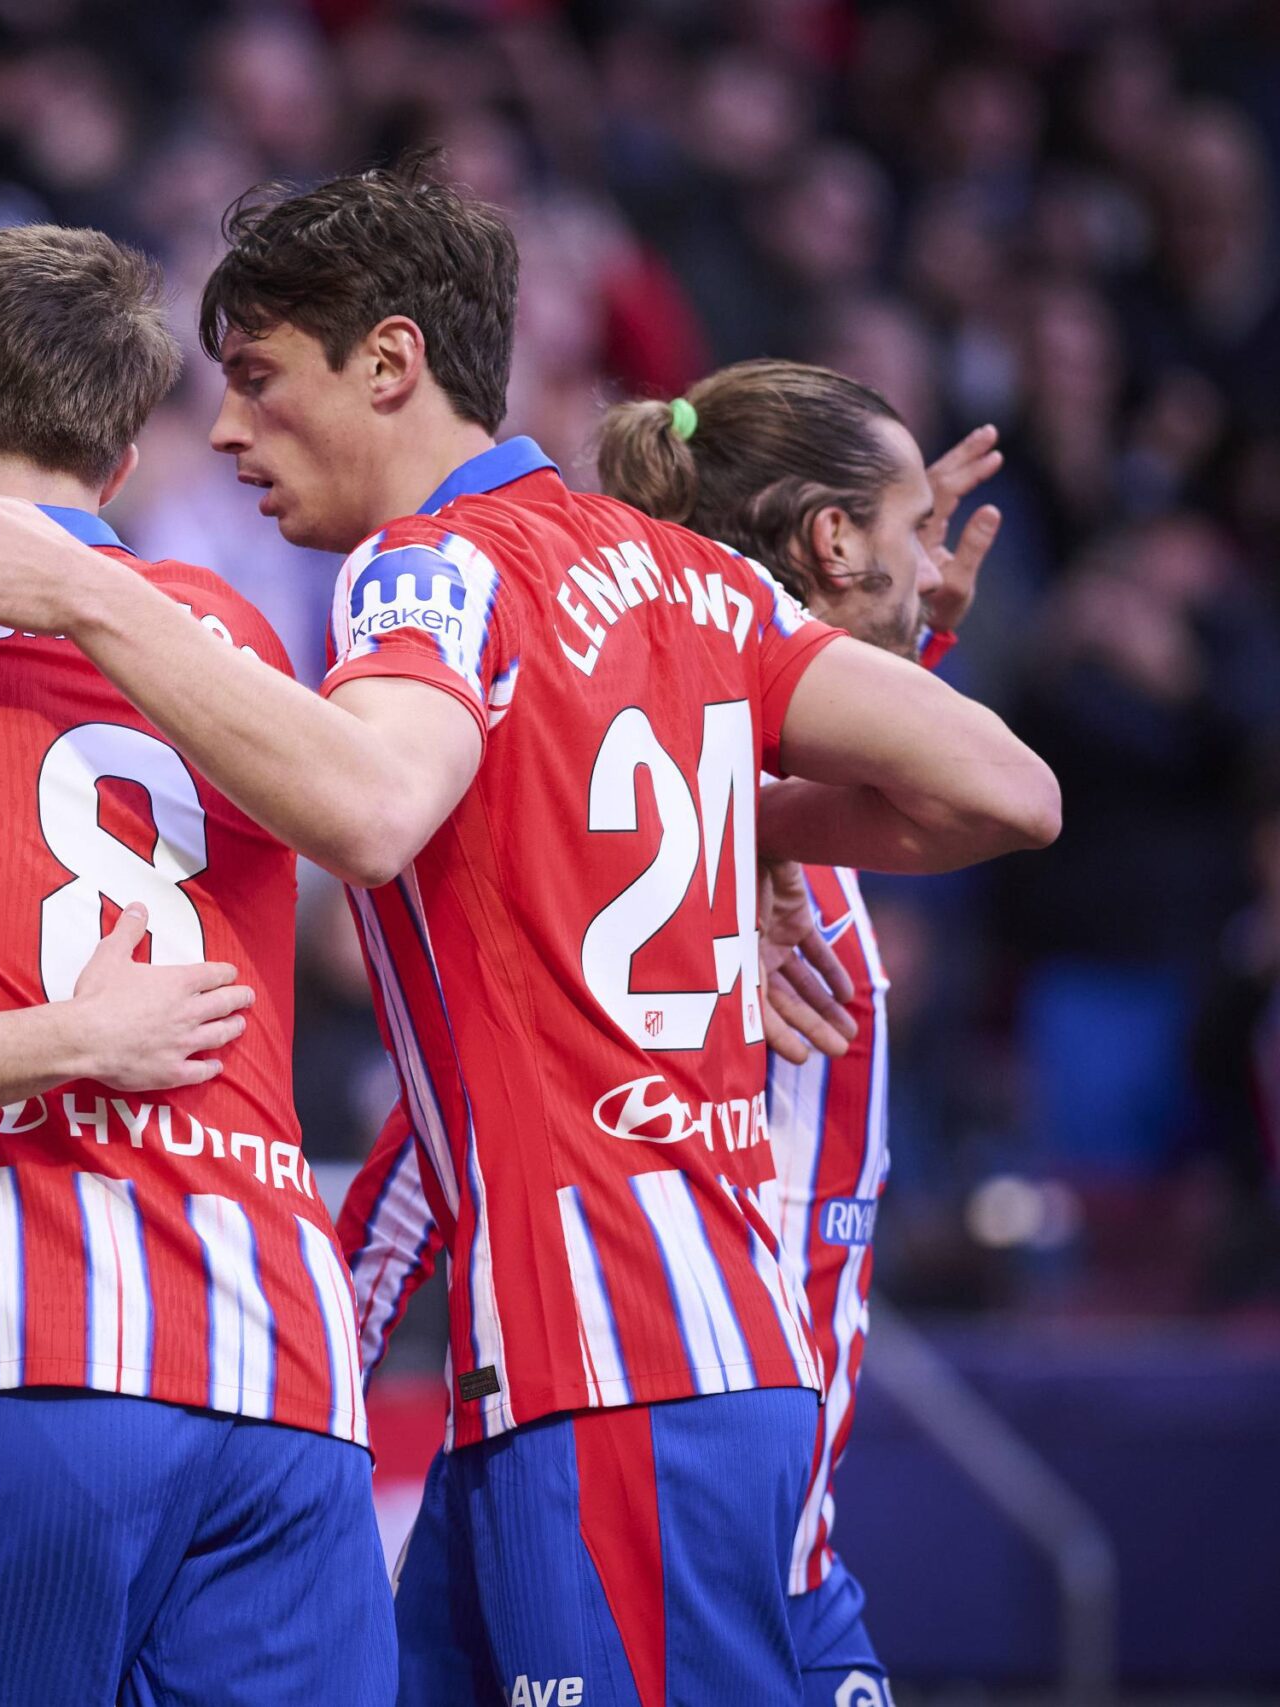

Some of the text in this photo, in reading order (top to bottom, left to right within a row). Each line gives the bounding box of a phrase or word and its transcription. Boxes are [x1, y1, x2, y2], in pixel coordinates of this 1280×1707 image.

[352, 608, 463, 645] kraken
[37, 722, 208, 1003] 8
[581, 698, 766, 1051] 24
